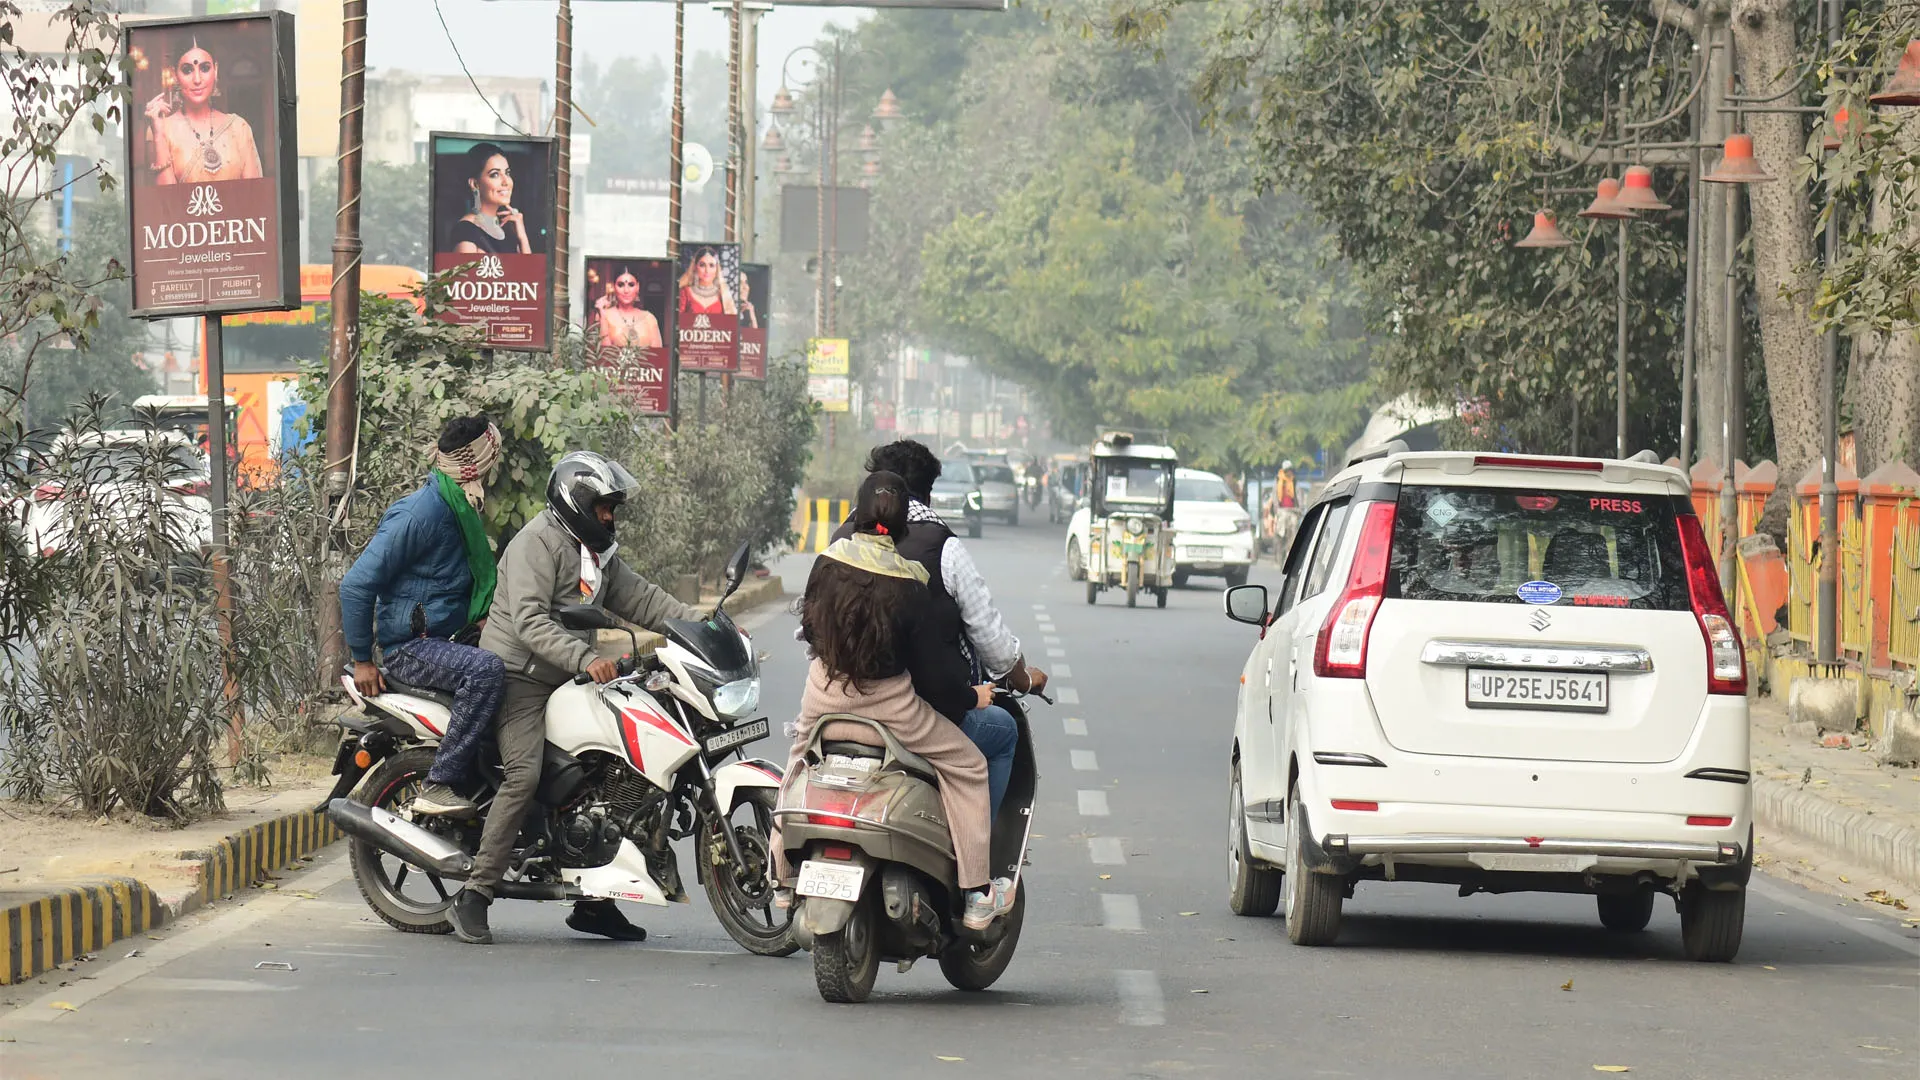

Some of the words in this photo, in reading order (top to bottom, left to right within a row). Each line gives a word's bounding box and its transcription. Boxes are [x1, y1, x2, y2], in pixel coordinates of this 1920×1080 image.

[143, 217, 267, 250] MODERN
[179, 251, 231, 265] Jewellers
[220, 265, 245, 273] perfection
[160, 282, 194, 293] BAREILLY
[223, 279, 252, 288] PILIBHIT
[443, 281, 538, 301] MODERN
[468, 304, 510, 313] Jewellers
[1432, 508, 1452, 516] CNG
[1590, 498, 1642, 514] PRESS
[1481, 676, 1602, 702] UP25EJ5641
[804, 880, 852, 899] 8675
